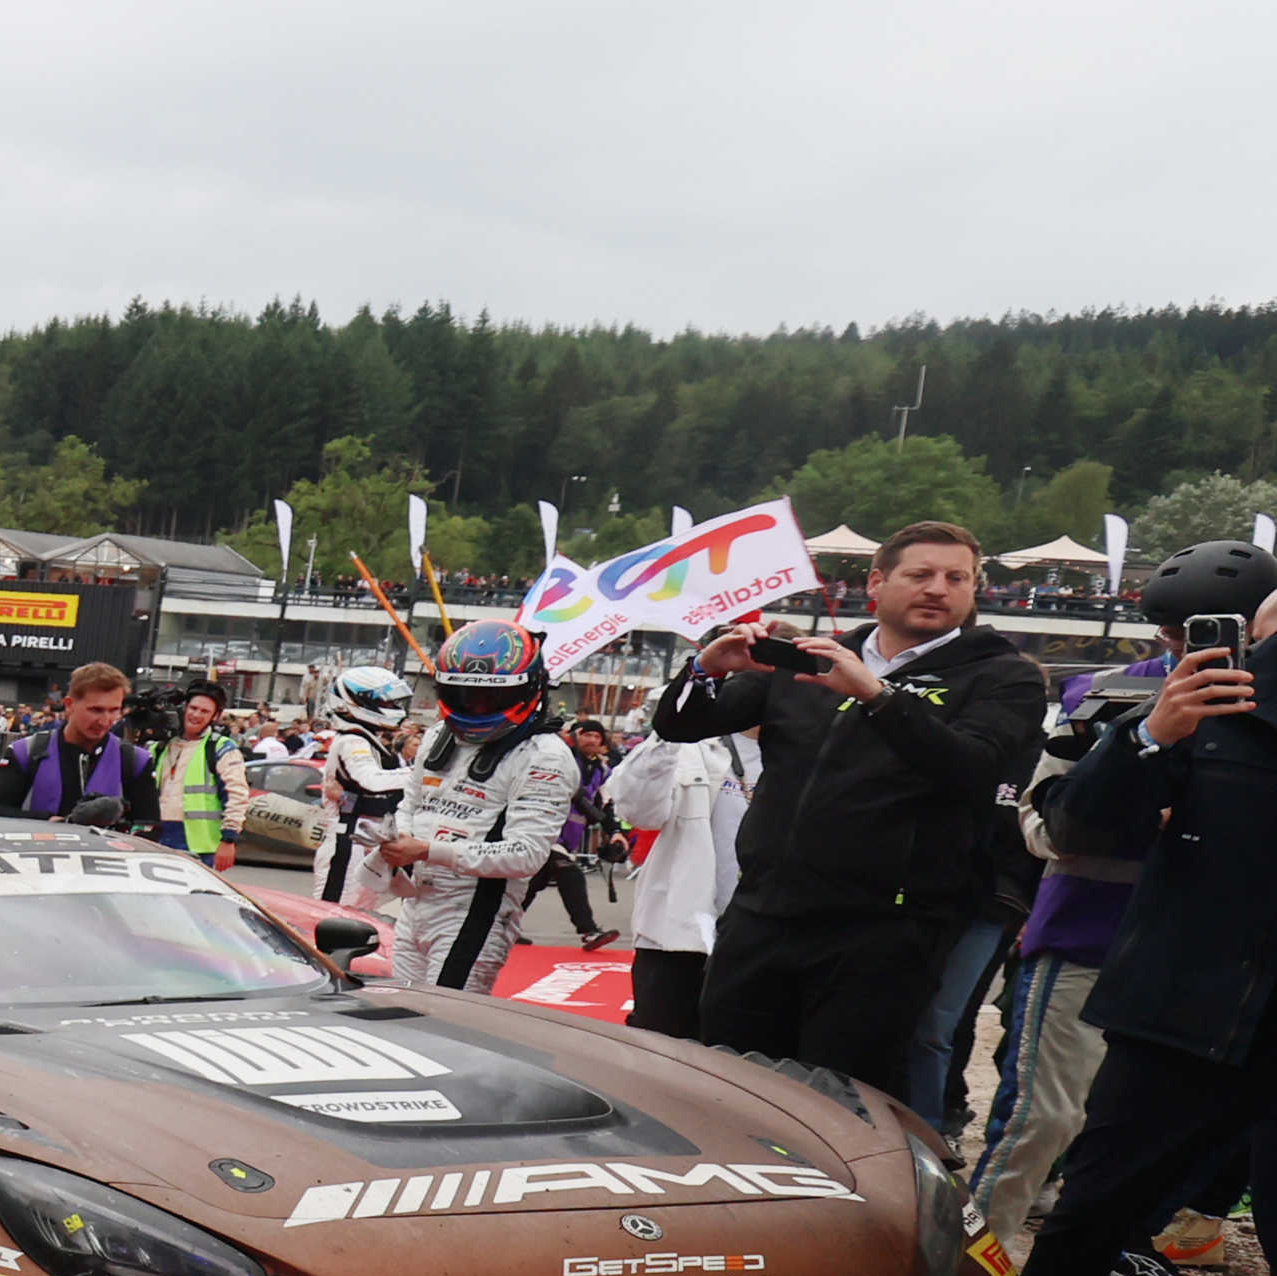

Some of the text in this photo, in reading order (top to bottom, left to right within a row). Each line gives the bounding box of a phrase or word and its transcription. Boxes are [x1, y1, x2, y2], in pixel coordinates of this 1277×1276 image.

[11, 635, 74, 650] PIRELLI
[248, 807, 304, 829] ECHERS
[493, 1162, 866, 1203] AMG
